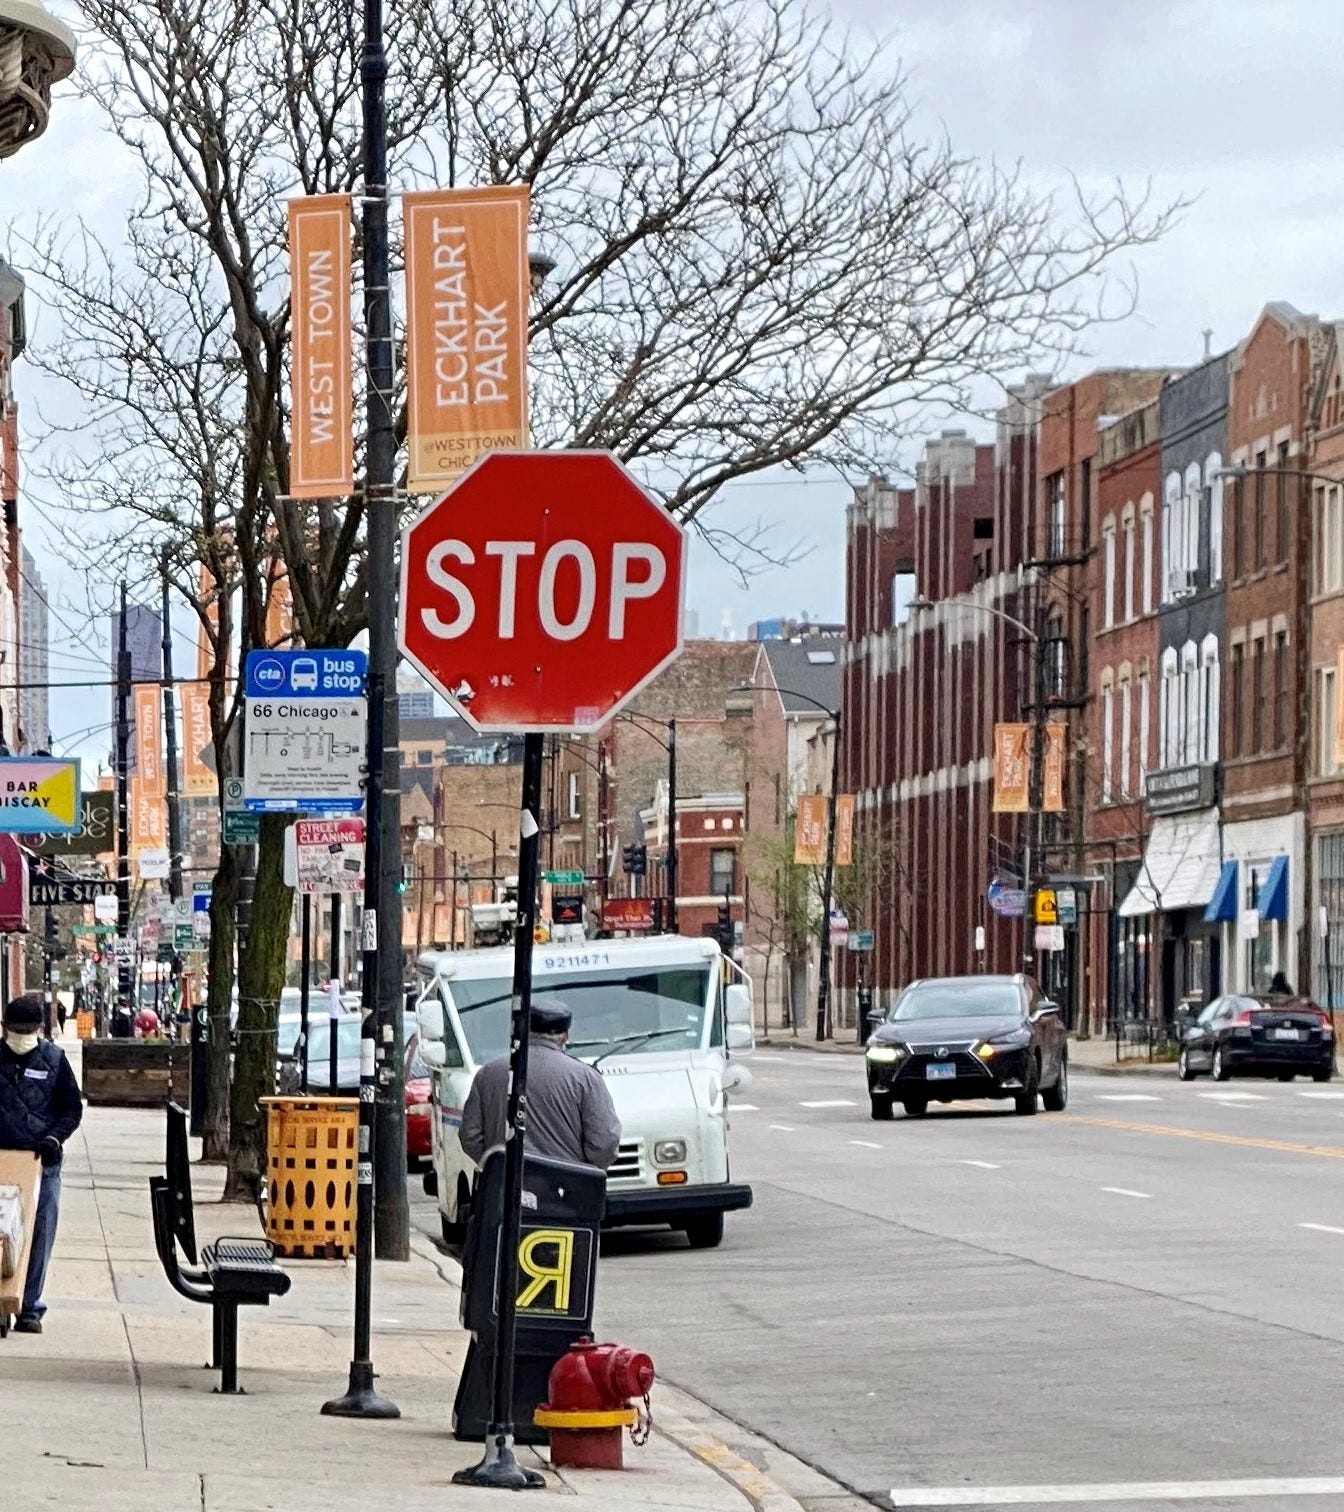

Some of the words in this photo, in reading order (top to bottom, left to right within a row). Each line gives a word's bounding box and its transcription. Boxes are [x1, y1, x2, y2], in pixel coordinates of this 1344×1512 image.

[308, 249, 333, 344] TOWN
[432, 217, 470, 408] ECKHART
[474, 300, 510, 404] PARK
[309, 356, 334, 445] WEST
[438, 455, 479, 469] CHIC
[420, 539, 667, 642] STOP
[323, 657, 355, 673] bus
[258, 668, 282, 680] cta
[323, 675, 361, 691] stop
[253, 704, 273, 718] 66
[277, 704, 339, 720] Chicago
[6, 781, 38, 792] BAR
[300, 822, 339, 833] STREET
[299, 832, 356, 843] CLEANING
[32, 885, 68, 902] FIVE
[544, 953, 610, 969] 9211471
